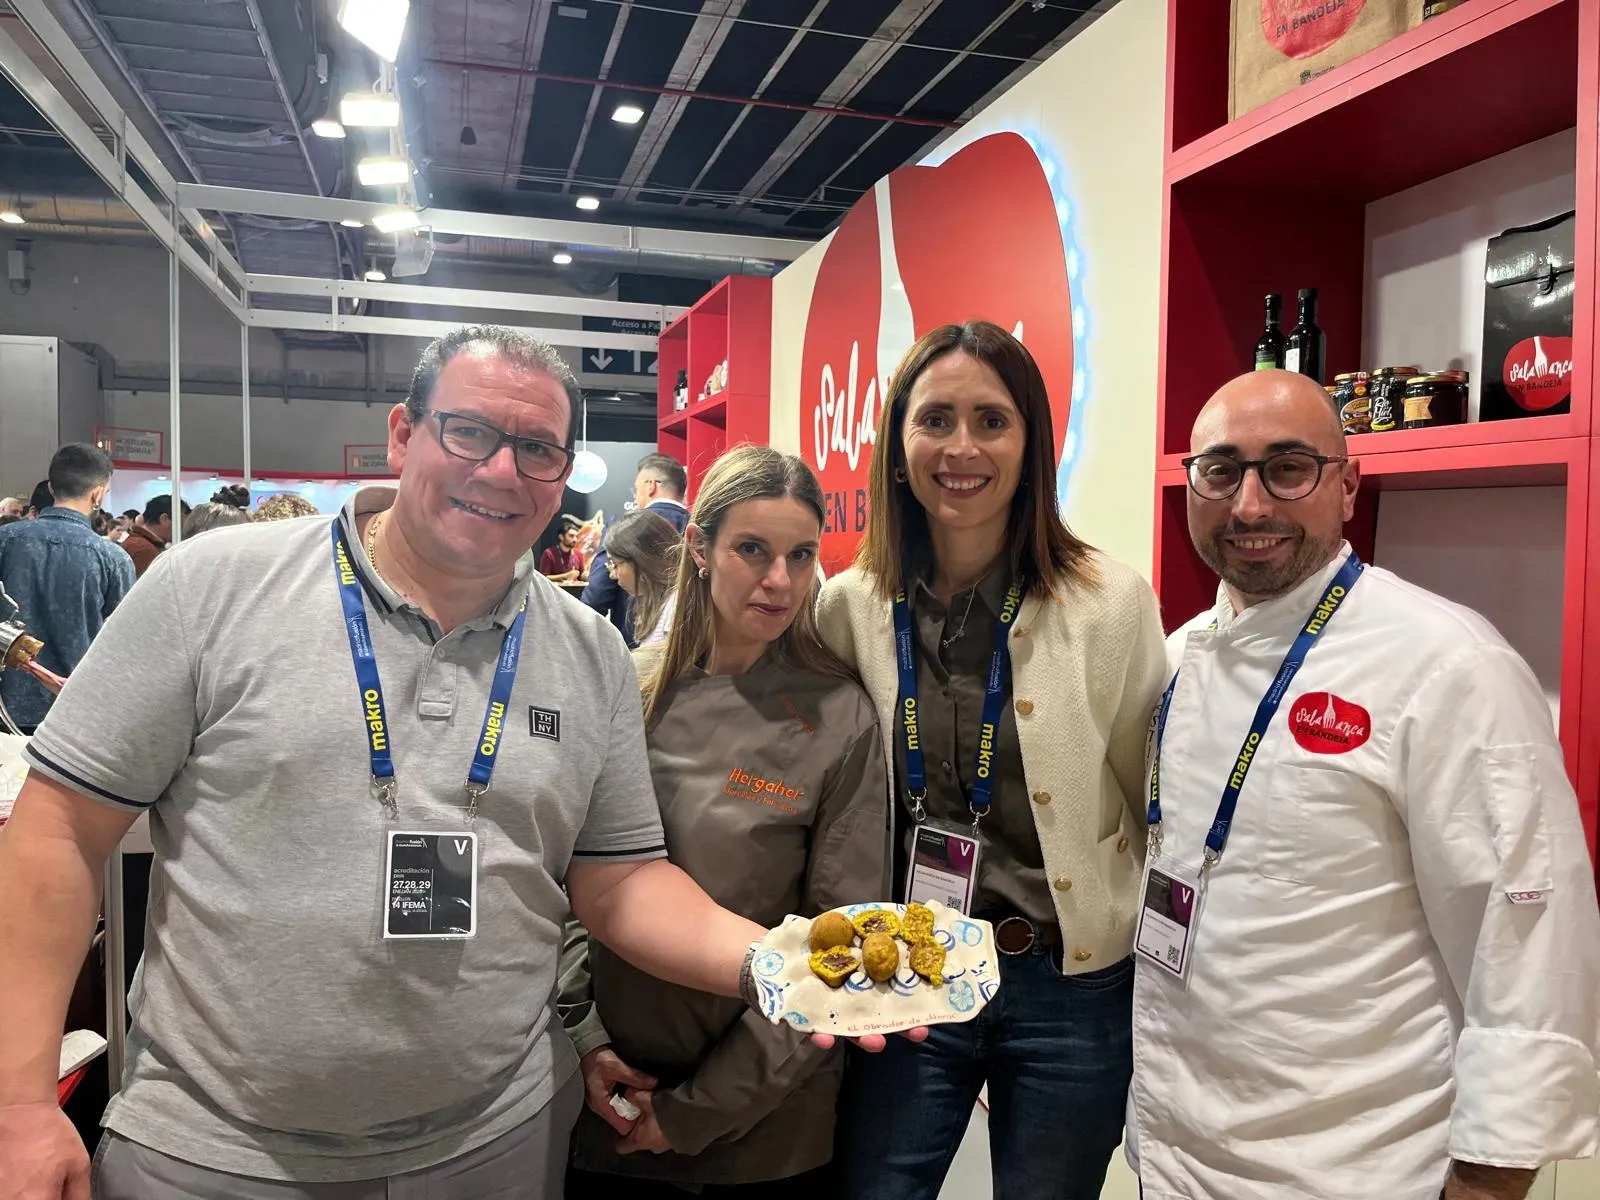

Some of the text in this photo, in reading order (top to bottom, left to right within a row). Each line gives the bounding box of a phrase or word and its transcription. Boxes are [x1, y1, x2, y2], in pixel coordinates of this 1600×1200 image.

[611, 319, 640, 329] Acceso
[1305, 585, 1345, 635] makro
[363, 688, 387, 751] makro
[537, 713, 552, 723] TH
[903, 697, 919, 752] makro
[480, 701, 506, 757] makro
[537, 723, 552, 733] NY
[977, 722, 995, 780] makro
[1229, 732, 1261, 790] makro
[453, 839, 469, 856] V
[960, 841, 972, 857] V
[1182, 887, 1191, 904] V
[402, 901, 427, 910] IFEMA
